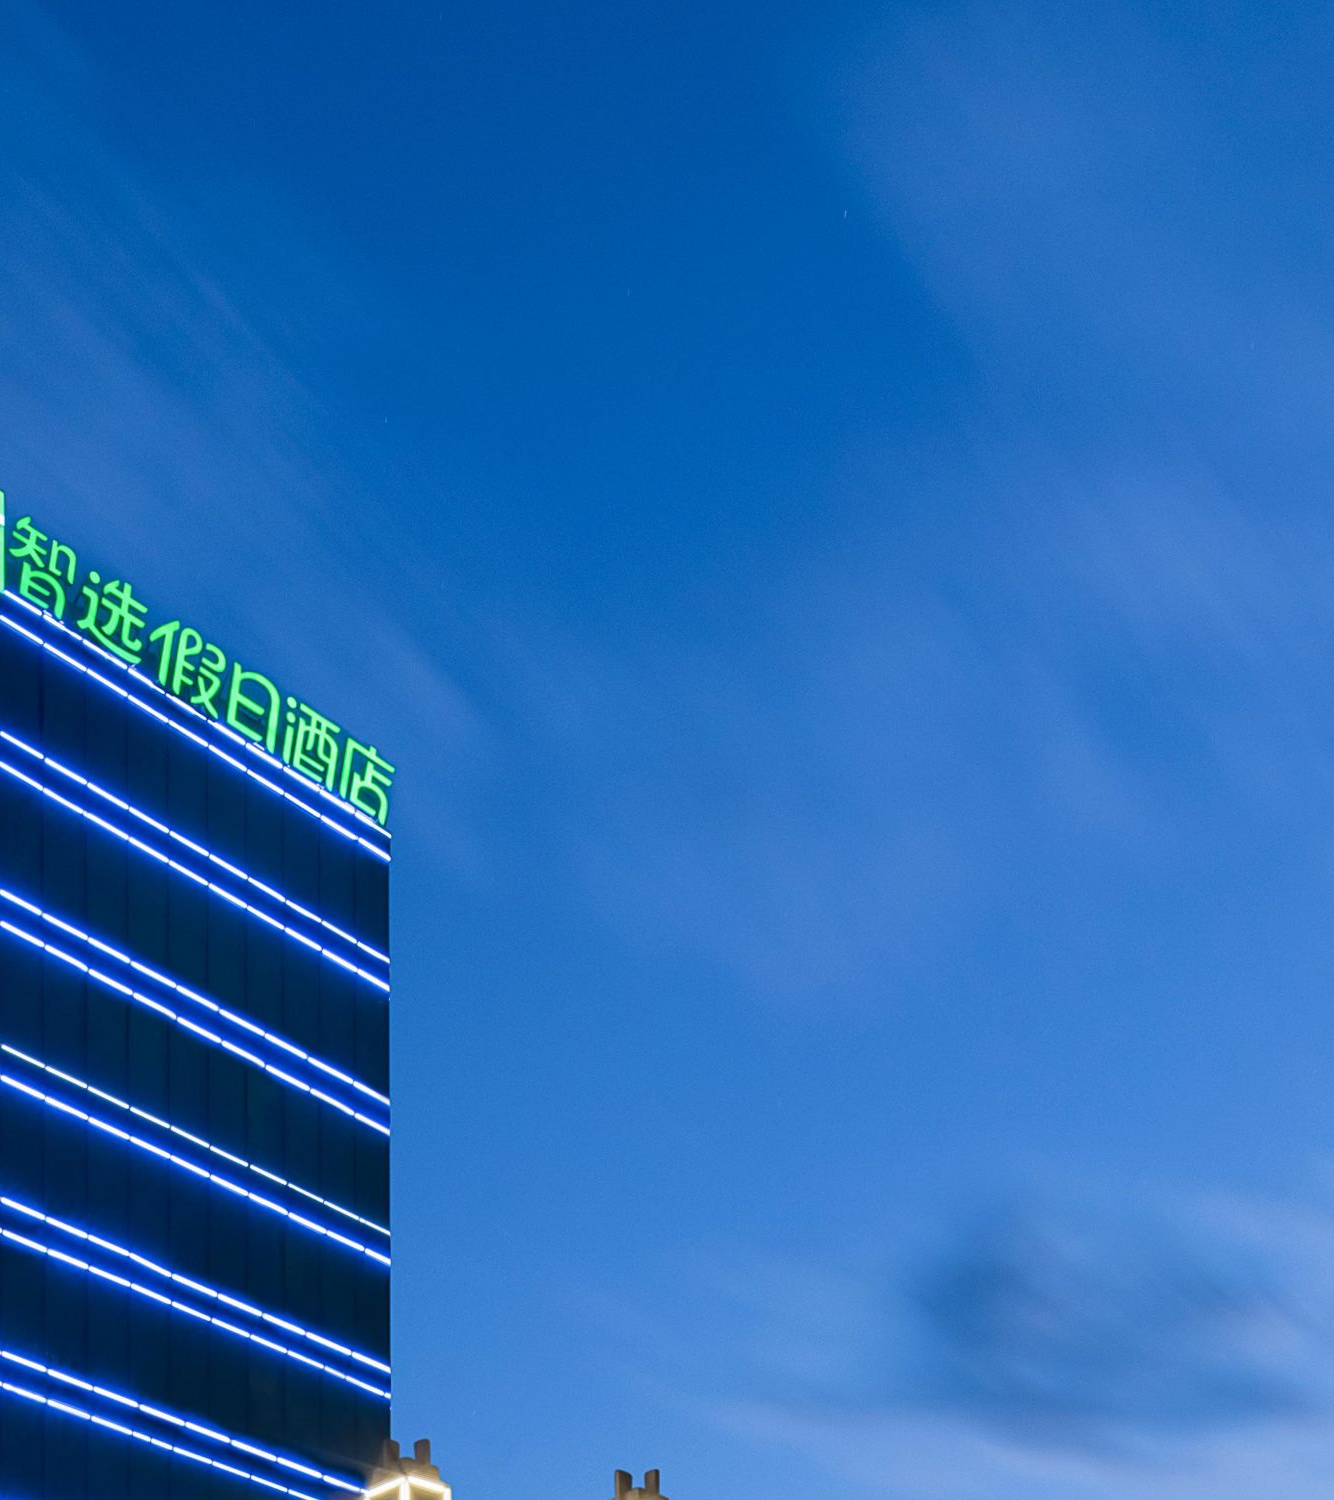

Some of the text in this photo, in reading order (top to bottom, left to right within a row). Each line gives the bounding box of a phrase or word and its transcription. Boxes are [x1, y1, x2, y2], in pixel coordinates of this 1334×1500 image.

[9, 516, 396, 825] 智选假日酒店
